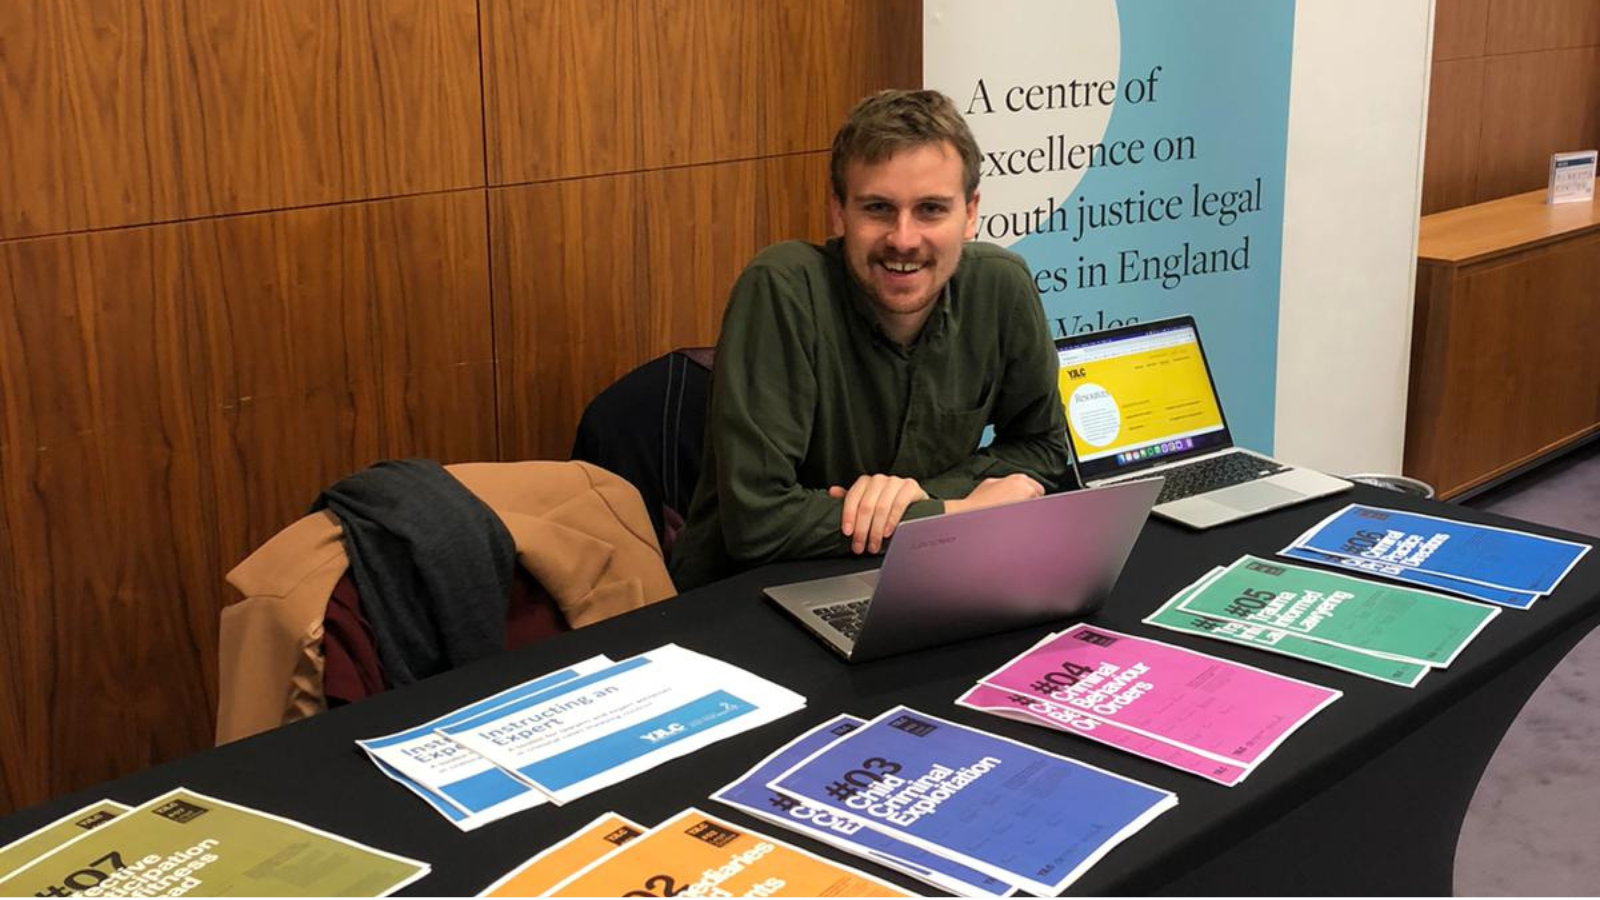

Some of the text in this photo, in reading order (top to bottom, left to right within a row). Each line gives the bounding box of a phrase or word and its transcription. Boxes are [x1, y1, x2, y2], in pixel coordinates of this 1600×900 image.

[965, 65, 1163, 115] A centre of
[1152, 135, 1196, 164] on
[1072, 190, 1183, 243] justice
[1191, 178, 1263, 226] legal
[1076, 255, 1108, 290] in
[1117, 236, 1250, 290] England
[1224, 588, 1277, 618] #05
[1030, 661, 1093, 694] #04
[1051, 661, 1120, 700] Criminal
[1070, 661, 1151, 709] Behaviour
[1093, 681, 1154, 715] Orders
[479, 695, 594, 741] Instructing
[592, 685, 620, 699] an
[491, 718, 565, 747] Expert
[825, 757, 902, 802] #03
[845, 773, 905, 810] Child
[868, 763, 954, 818] Criminal
[887, 755, 1002, 827] Exploitation
[71, 854, 161, 897] ective
